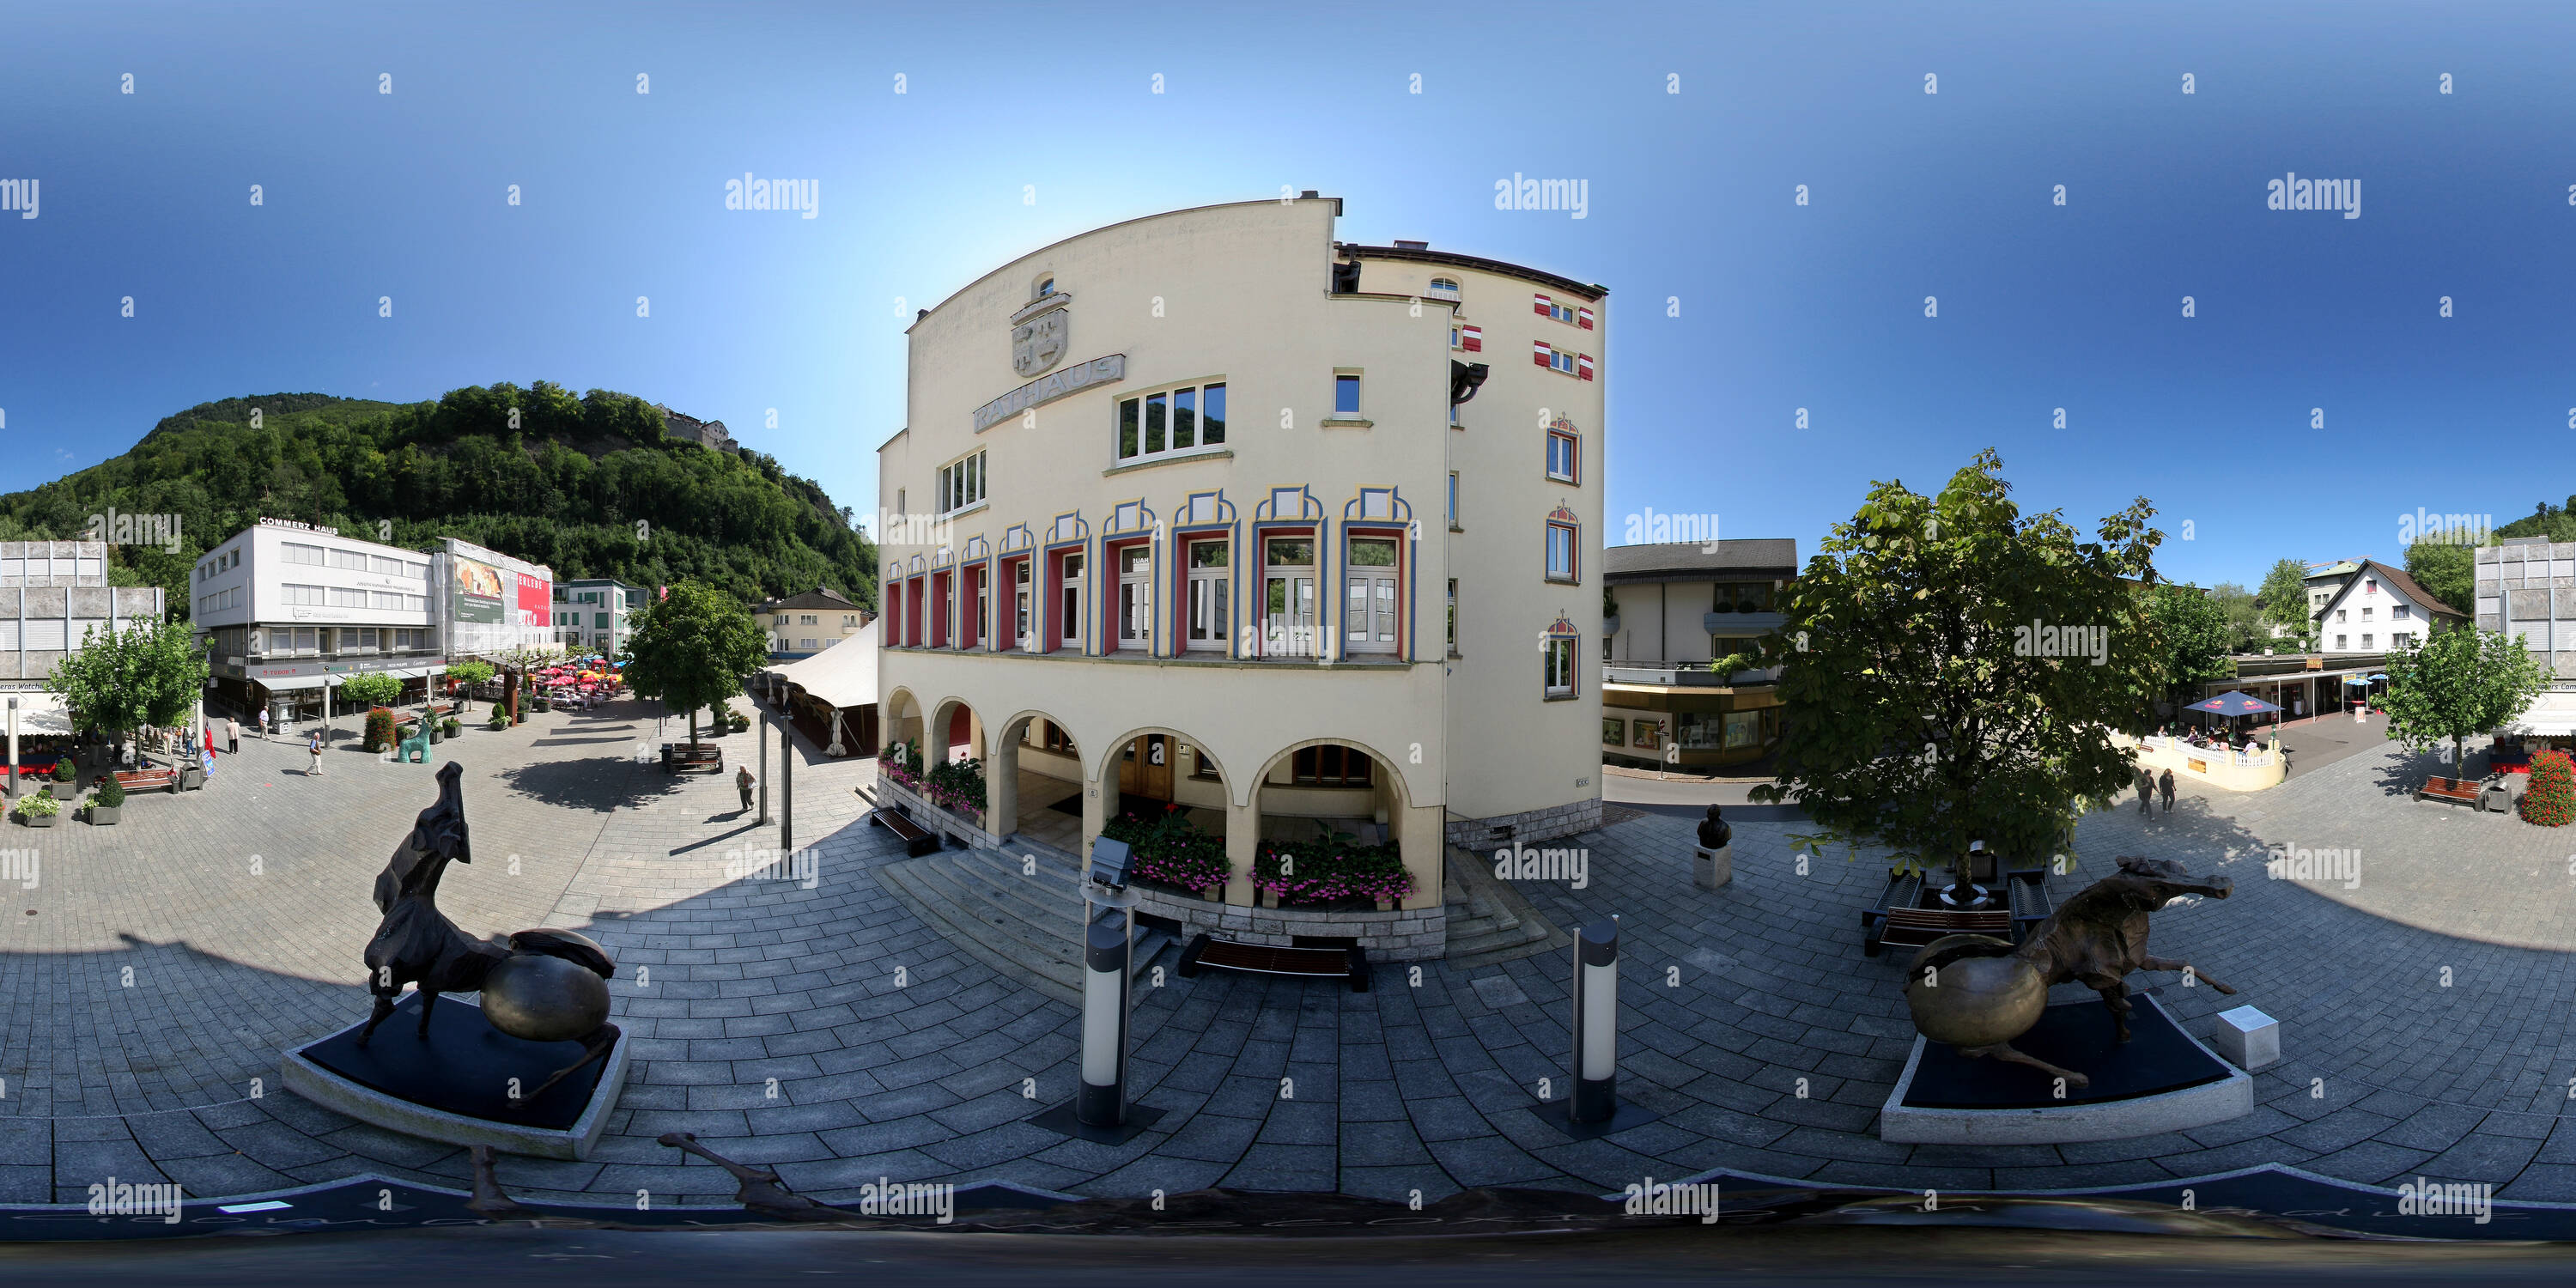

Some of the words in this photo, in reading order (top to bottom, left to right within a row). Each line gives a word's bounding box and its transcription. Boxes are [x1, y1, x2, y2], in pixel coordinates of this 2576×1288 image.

[975, 355, 1117, 429] RATHAUS
[259, 517, 311, 531] COMMERZ
[314, 525, 338, 535] HAUS
[519, 575, 542, 590] ERLEBE
